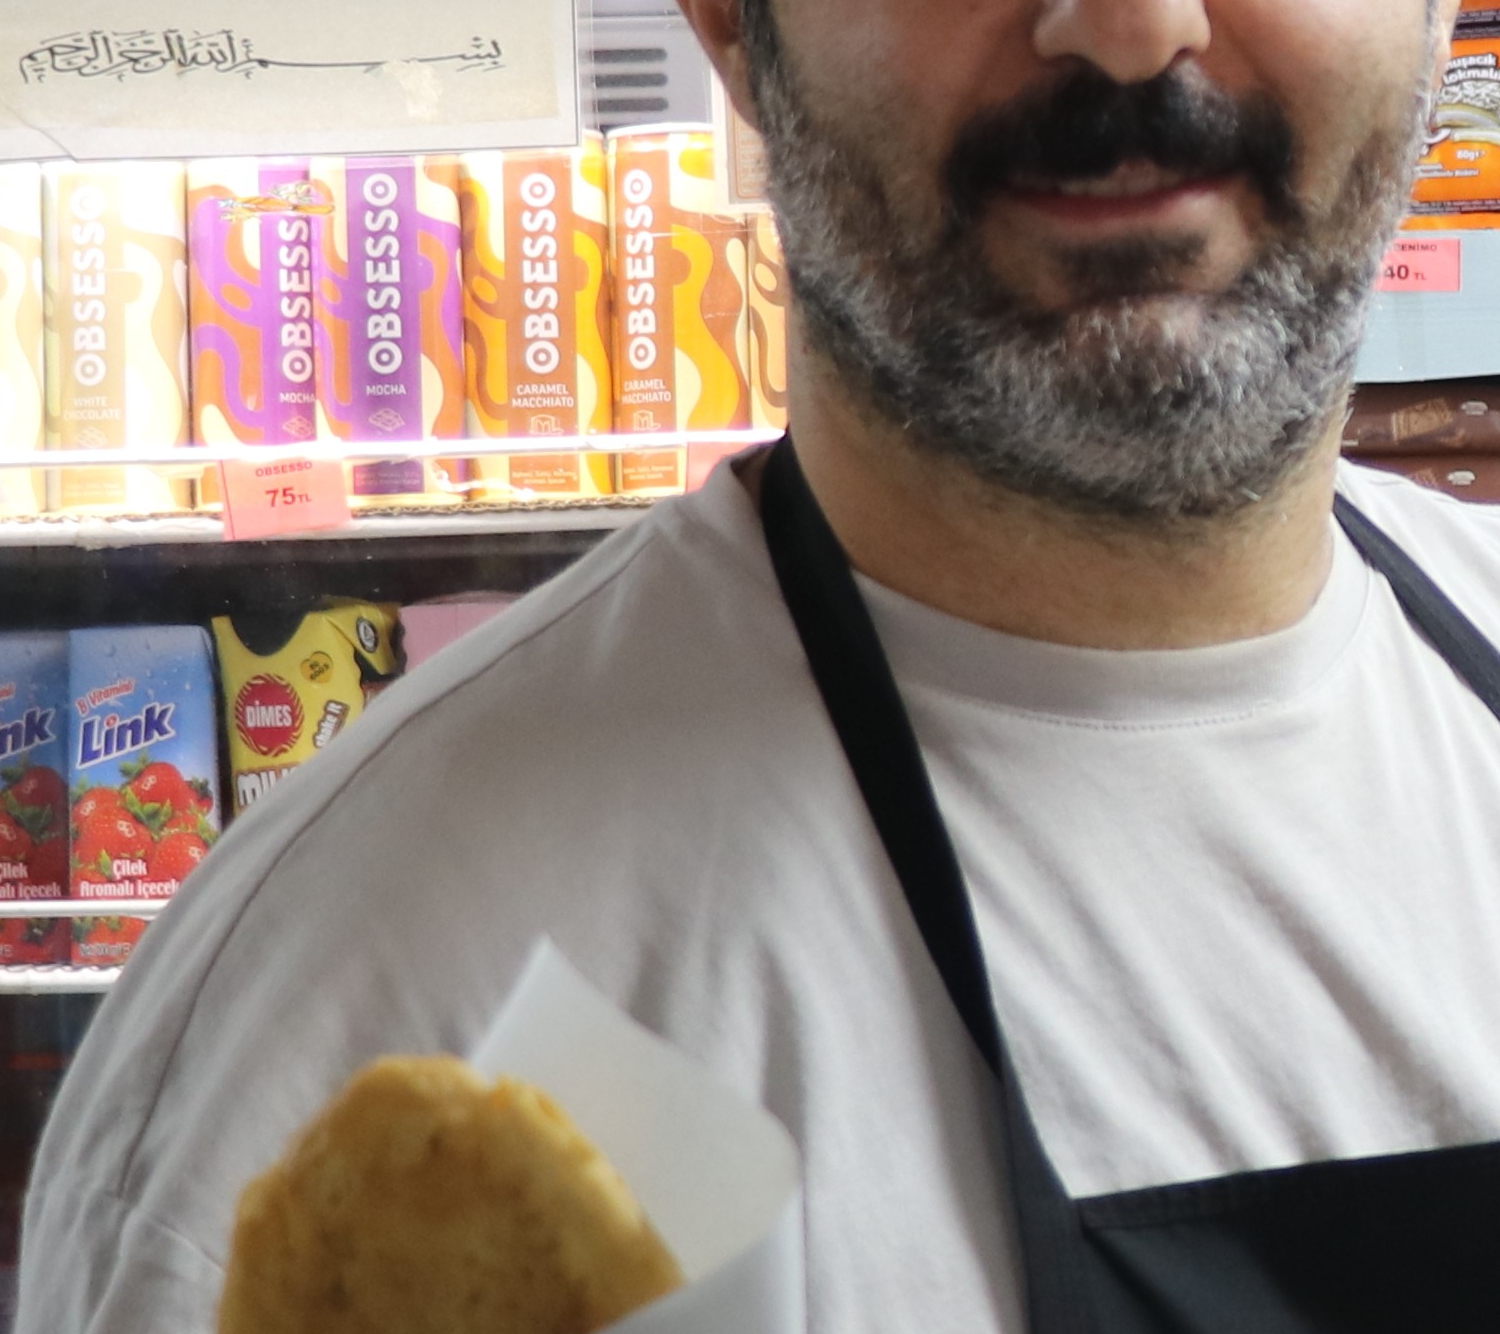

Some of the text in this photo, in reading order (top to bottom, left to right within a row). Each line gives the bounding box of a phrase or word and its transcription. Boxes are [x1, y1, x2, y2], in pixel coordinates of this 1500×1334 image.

[363, 173, 403, 375] OBSESSO
[520, 173, 560, 374] OBSESSO
[624, 169, 657, 370] OBSESSO
[1385, 265, 1409, 280] 40
[71, 185, 106, 387] OBSESSO
[367, 384, 406, 396] MOCHA
[517, 384, 568, 395] CARAMEL
[624, 379, 665, 391] CARAMEL
[73, 396, 107, 407] WHITE
[512, 396, 574, 408] MACCHIATO
[621, 391, 671, 404] MACCHIATO
[256, 462, 312, 477] OBSESSO
[266, 487, 312, 507] 75 TL
[246, 700, 292, 728] DİMES
[77, 703, 176, 769] Link
[112, 860, 147, 881] Çilek
[81, 881, 133, 897] Aromalı
